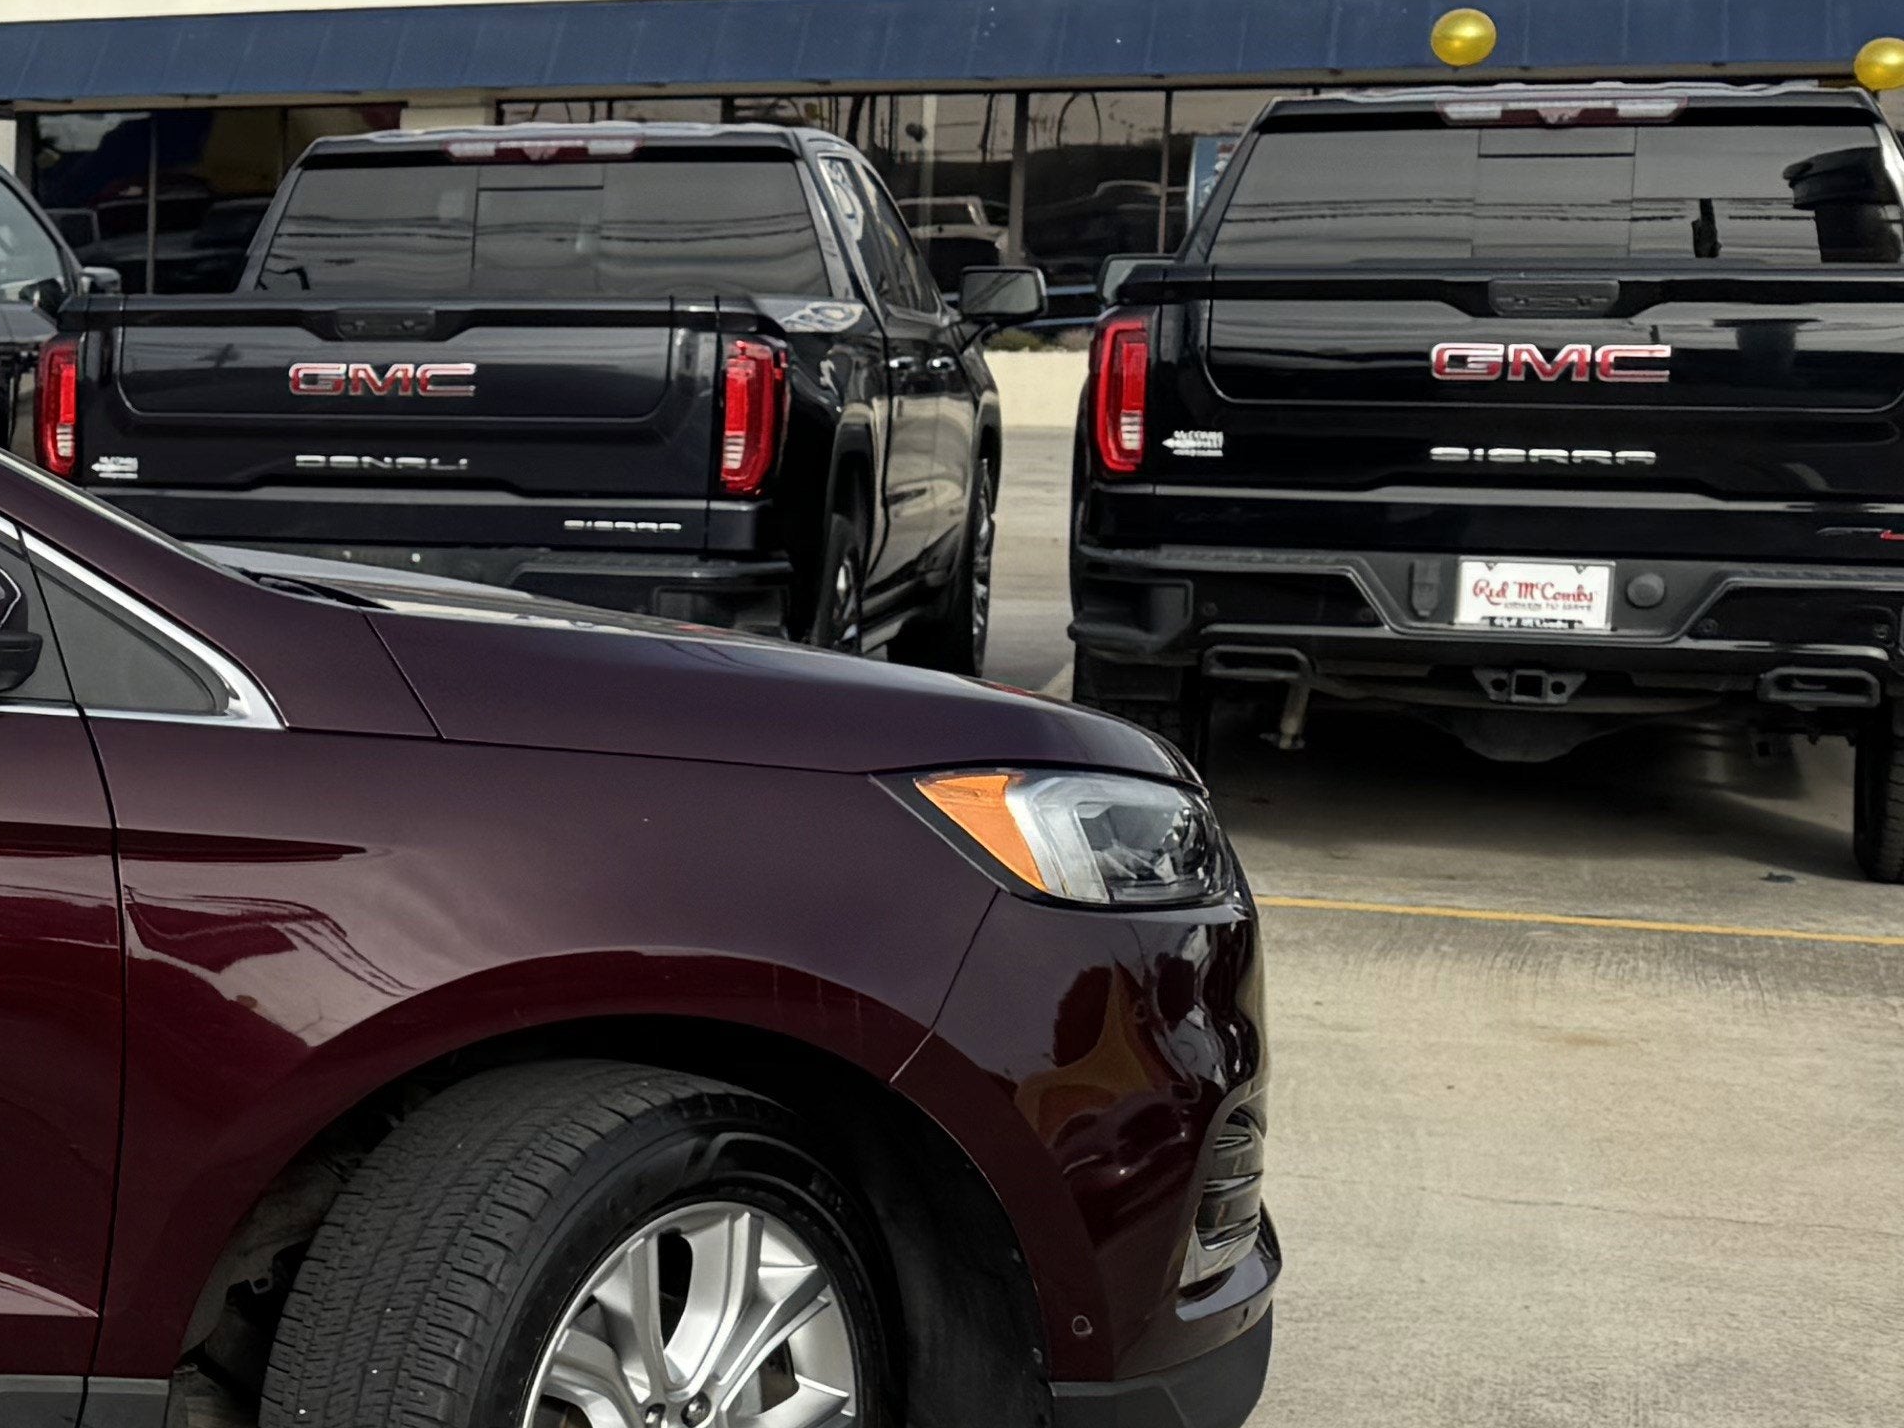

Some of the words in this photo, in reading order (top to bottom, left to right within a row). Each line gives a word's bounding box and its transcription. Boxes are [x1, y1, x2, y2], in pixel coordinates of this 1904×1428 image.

[1431, 342, 1672, 383] GMC
[288, 362, 477, 397] GMC
[295, 454, 468, 471] DENALI
[1429, 446, 1657, 465] SIERRA
[563, 519, 682, 533] SIERRA
